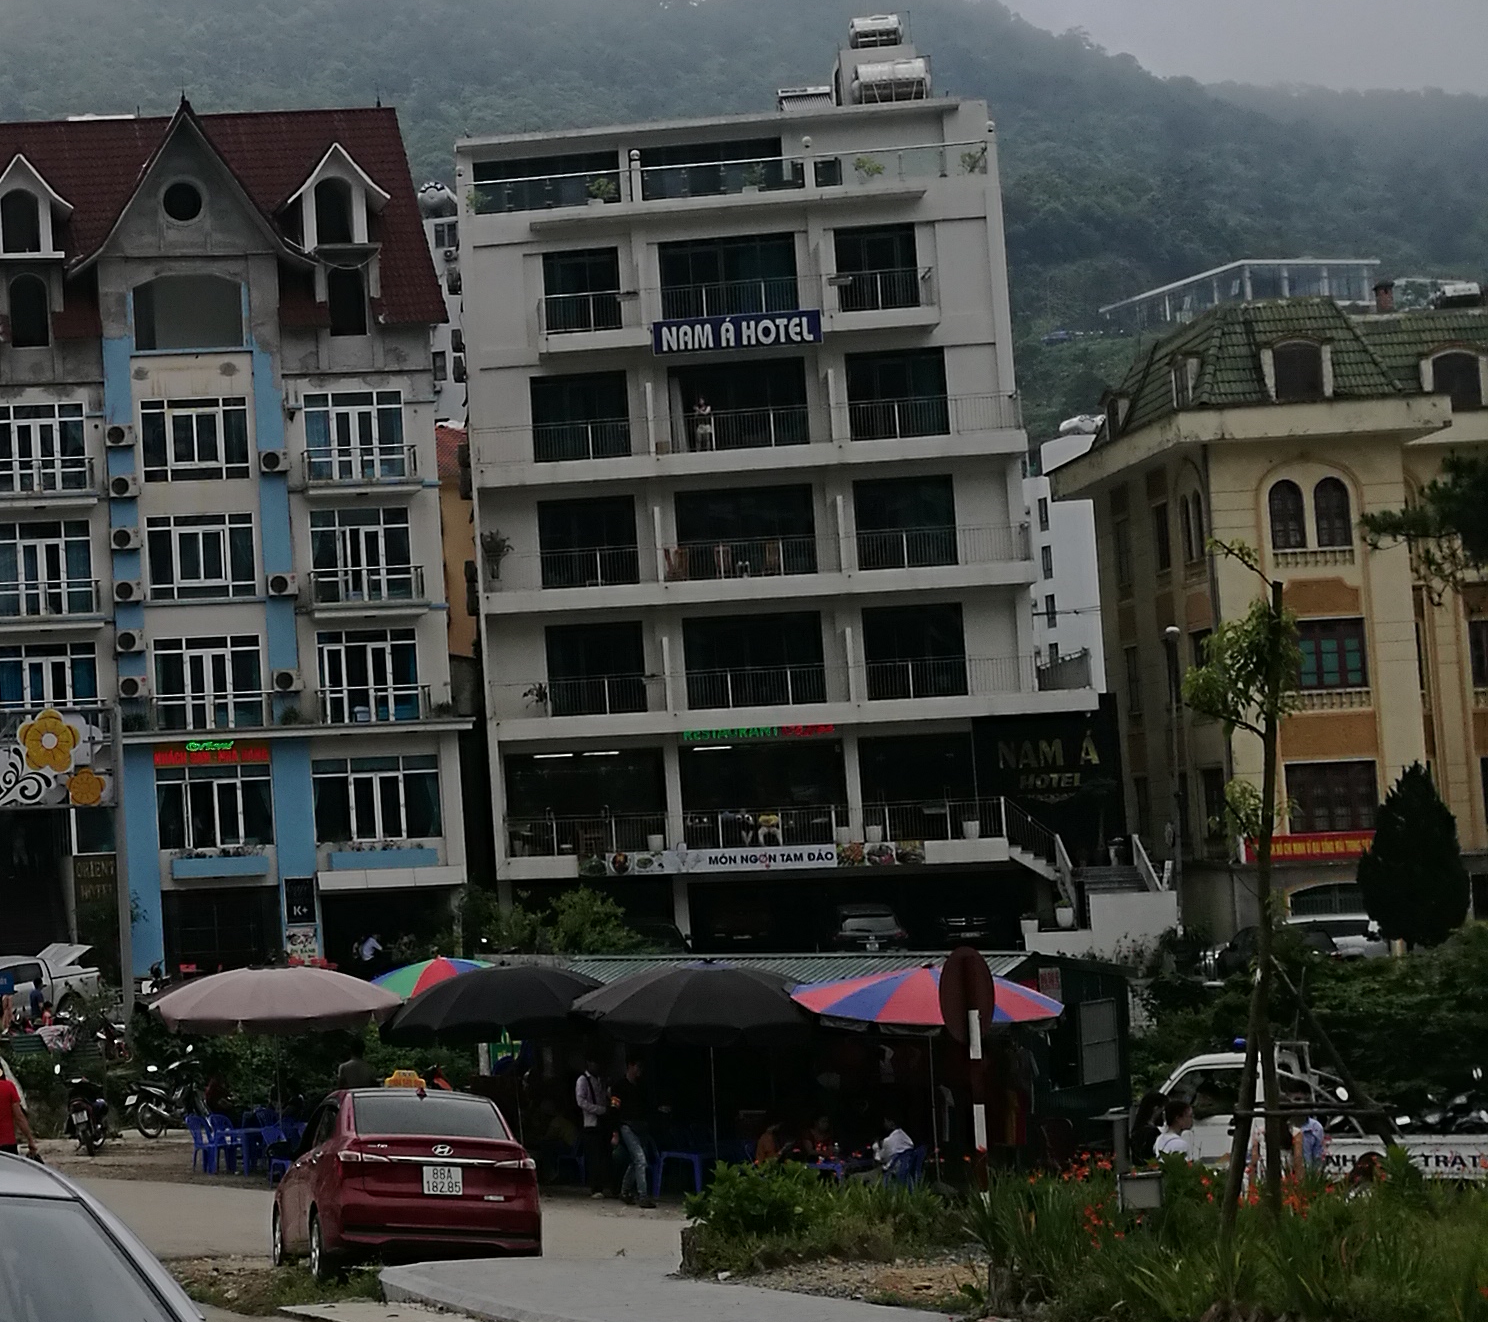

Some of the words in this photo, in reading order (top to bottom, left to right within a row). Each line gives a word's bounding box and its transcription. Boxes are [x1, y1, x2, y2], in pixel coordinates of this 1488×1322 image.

[661, 323, 715, 352] NAM
[720, 317, 736, 348] Á
[741, 316, 815, 346] HOTEL
[997, 738, 1065, 769] NAM
[708, 853, 737, 865] MÓN
[780, 851, 804, 863] TAM
[432, 1167, 453, 1180] 88A
[426, 1180, 462, 1194] 182.85
